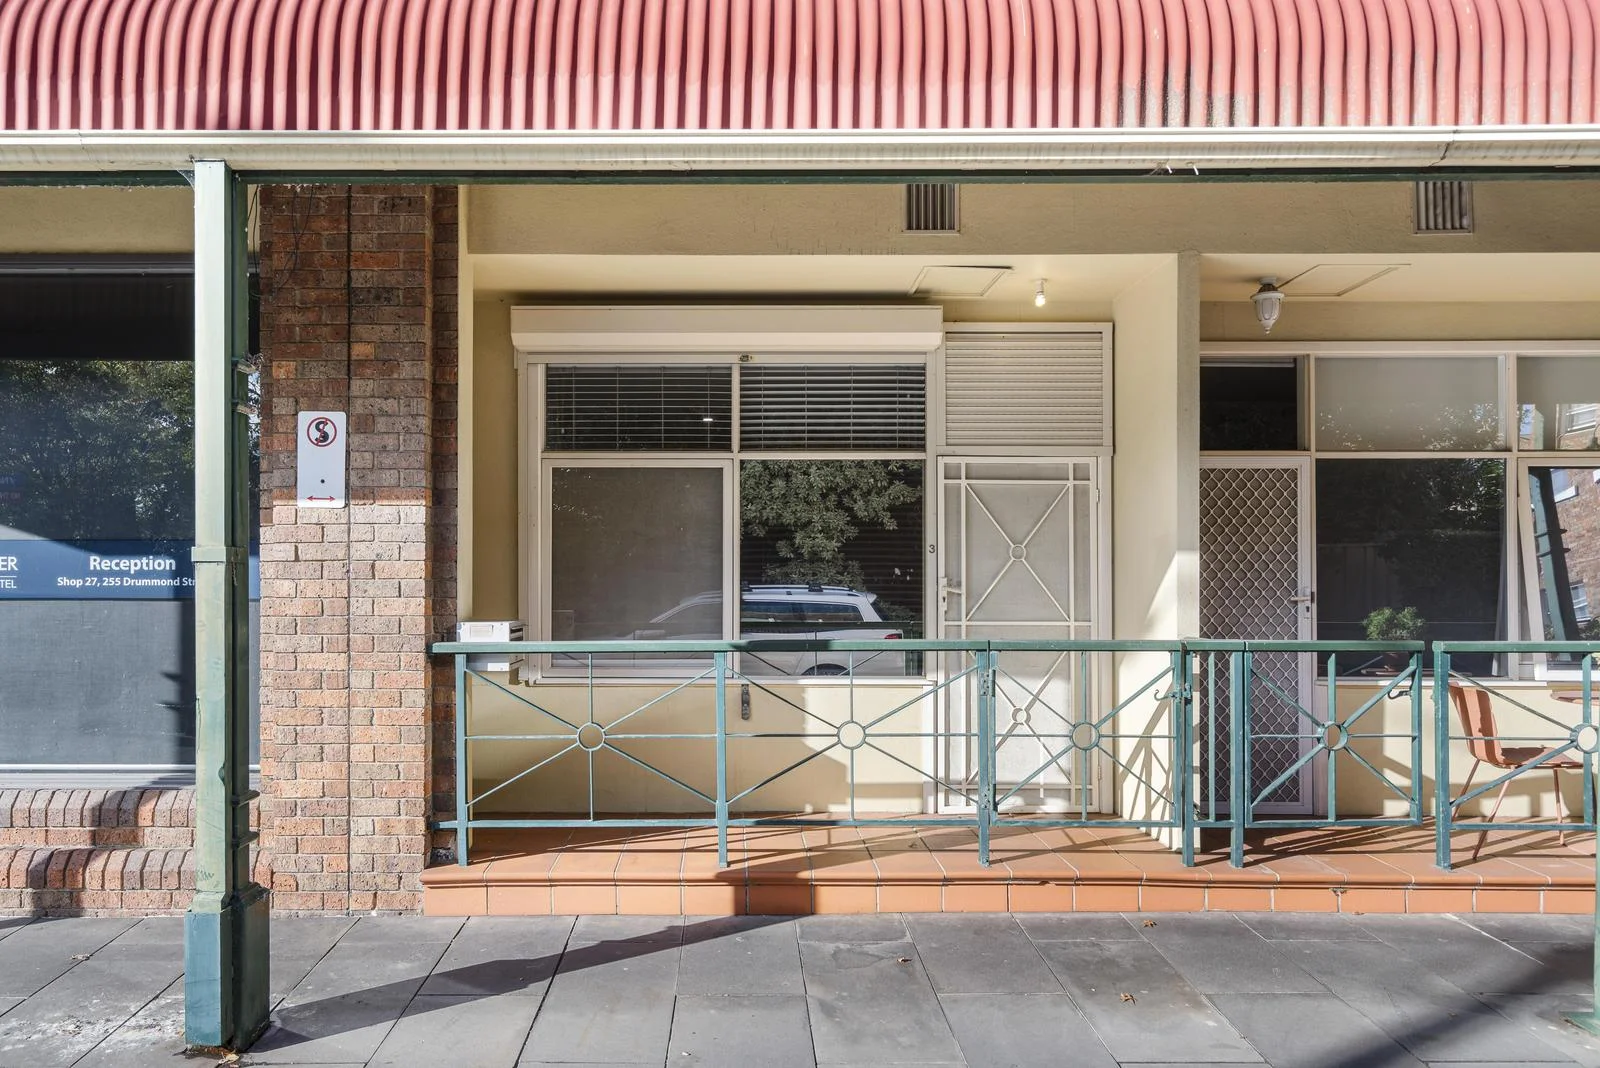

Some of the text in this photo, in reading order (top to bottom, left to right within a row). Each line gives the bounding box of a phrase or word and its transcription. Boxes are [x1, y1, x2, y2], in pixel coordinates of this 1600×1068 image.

[928, 544, 935, 553] 3
[89, 555, 176, 574] Reception
[57, 576, 83, 588] Shop
[84, 577, 100, 587] 27,
[102, 577, 121, 586] 255
[123, 576, 180, 586] Drummond
